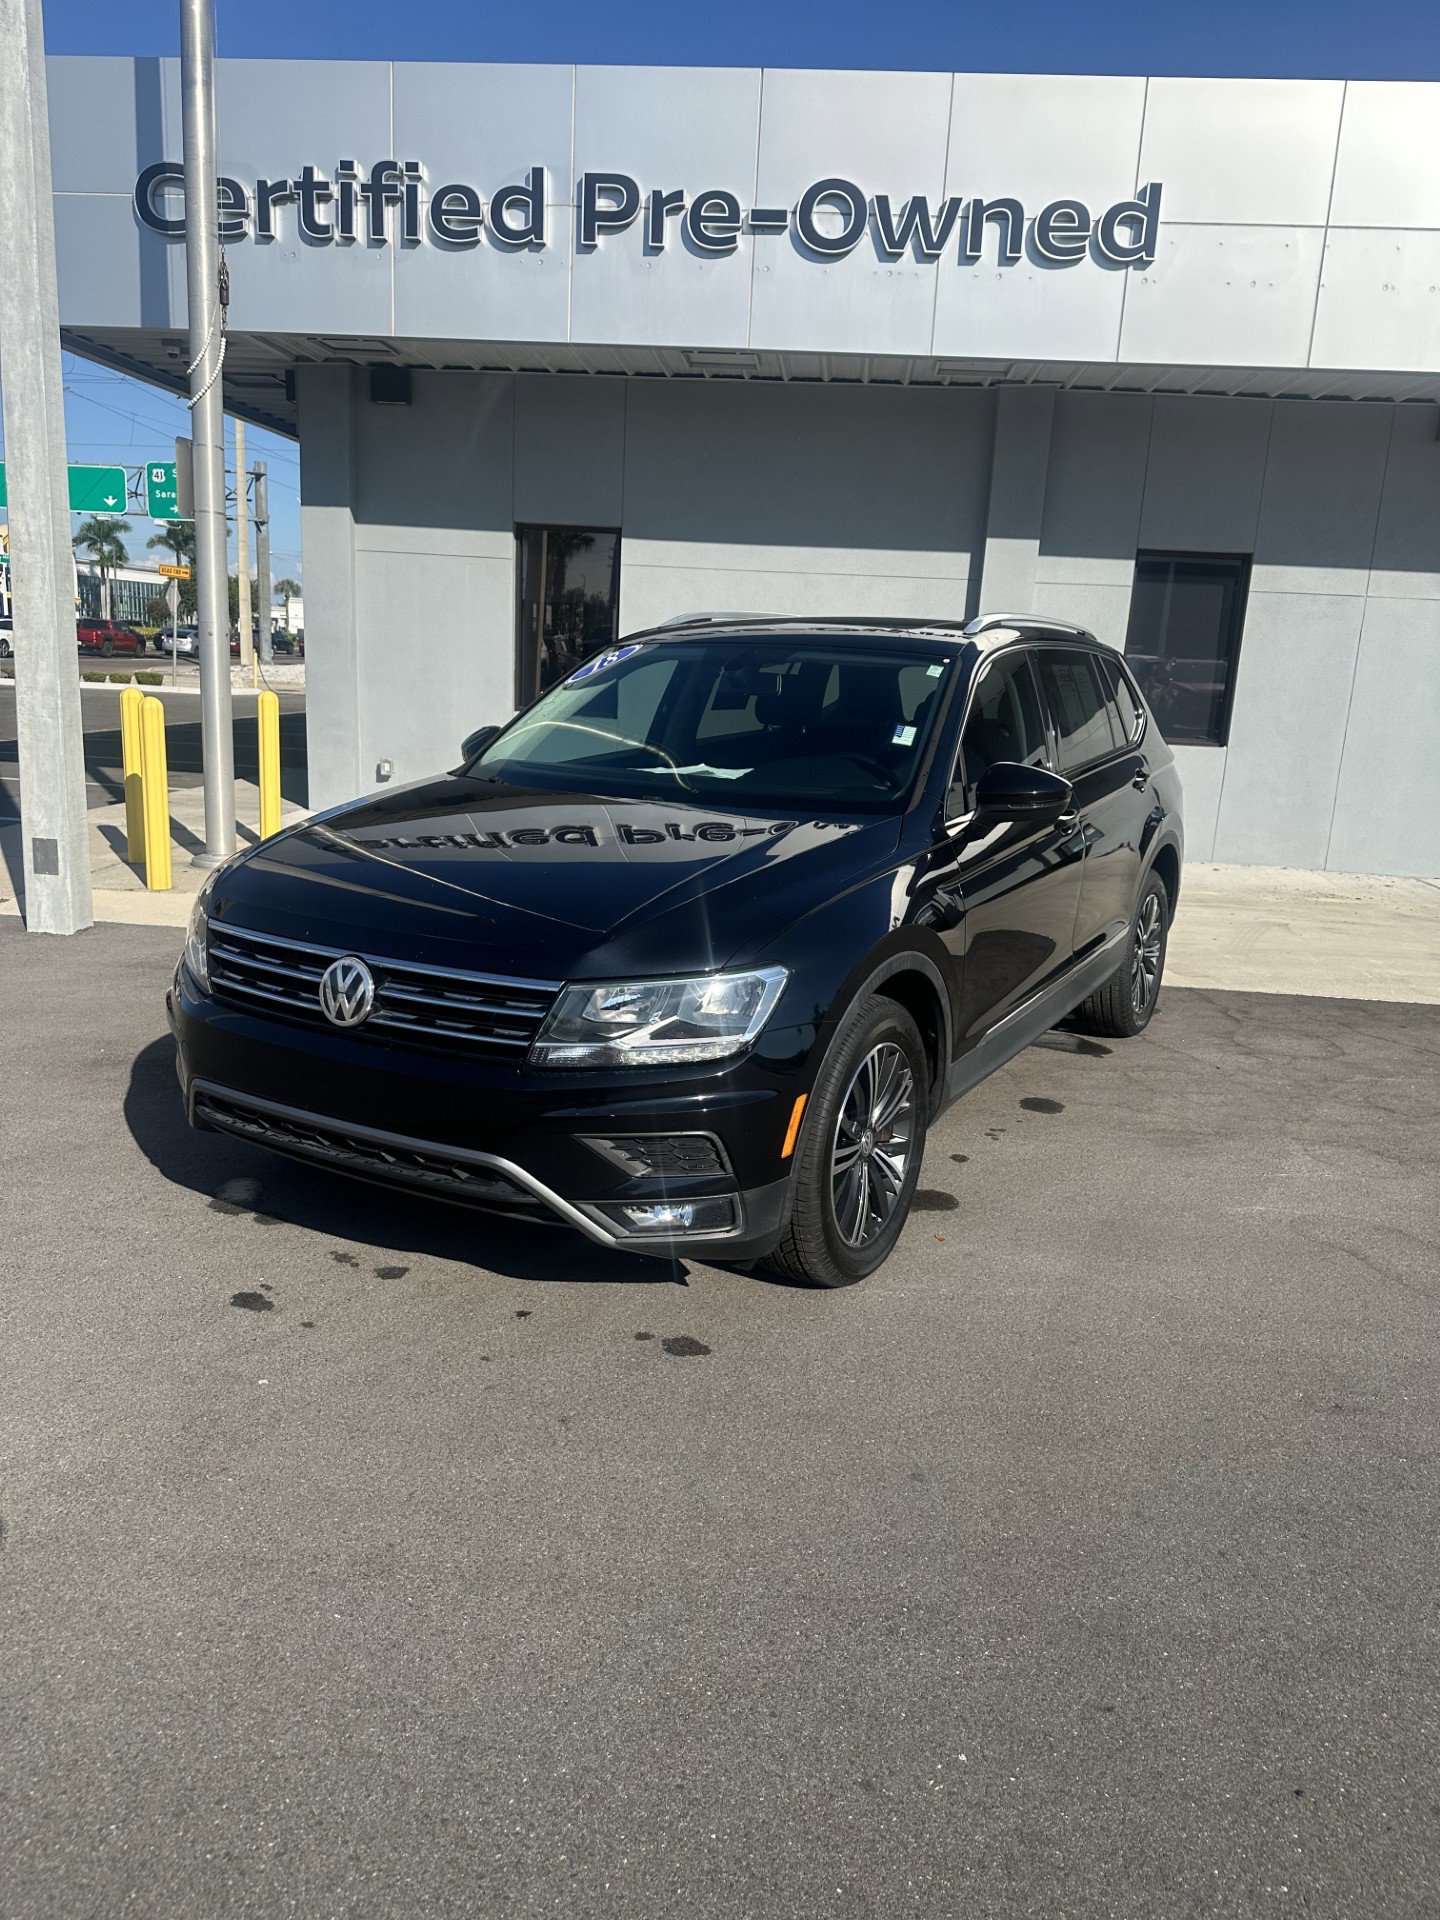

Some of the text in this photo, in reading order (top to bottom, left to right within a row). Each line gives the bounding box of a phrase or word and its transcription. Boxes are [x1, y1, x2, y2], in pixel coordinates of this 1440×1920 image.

[134, 159, 1163, 262] Certified Pre-Owned
[154, 471, 163, 480] 41
[319, 955, 375, 1028] VW
